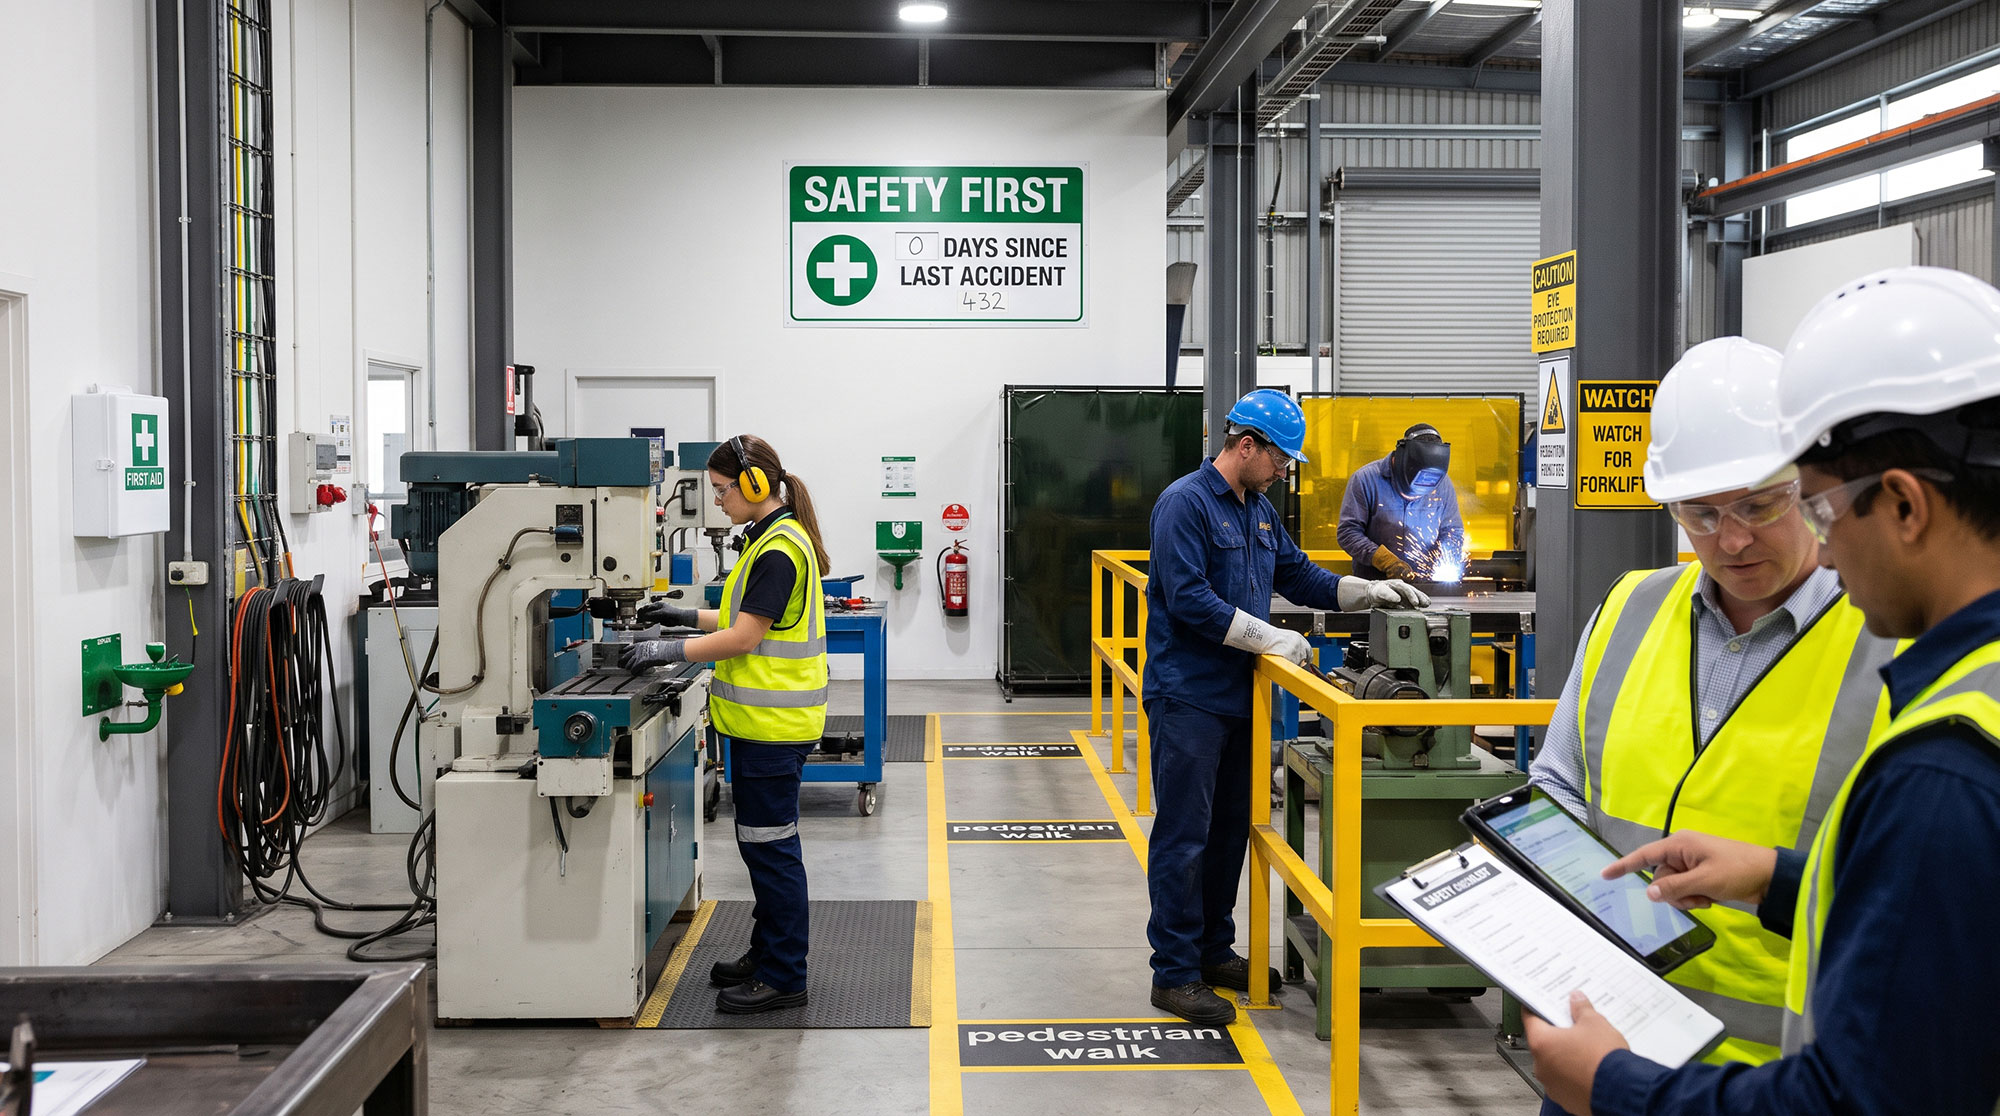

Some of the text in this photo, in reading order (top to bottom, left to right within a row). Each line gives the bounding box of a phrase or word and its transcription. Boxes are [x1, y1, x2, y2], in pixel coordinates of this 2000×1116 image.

[804, 175, 1069, 213] SAFETY FIRST
[944, 237, 1068, 259] DAYS SINCE
[900, 265, 1067, 287] LAST ACCIDENT
[1534, 260, 1573, 290] CAUTION
[962, 291, 1006, 312] 432
[1547, 291, 1559, 308] EYE
[1533, 306, 1573, 329] PROTECTION
[1537, 325, 1569, 346] REQUIRED
[1584, 389, 1654, 408] WATCH
[1593, 425, 1642, 443] WATCH
[1604, 451, 1632, 468] FOR
[126, 472, 163, 486] FIRST AID
[953, 824, 1114, 833] pedestrian
[1000, 831, 1072, 839] walk
[1422, 885, 1456, 906] SAFETY
[968, 1026, 1222, 1046] pedestrian
[1043, 1044, 1160, 1060] walk
